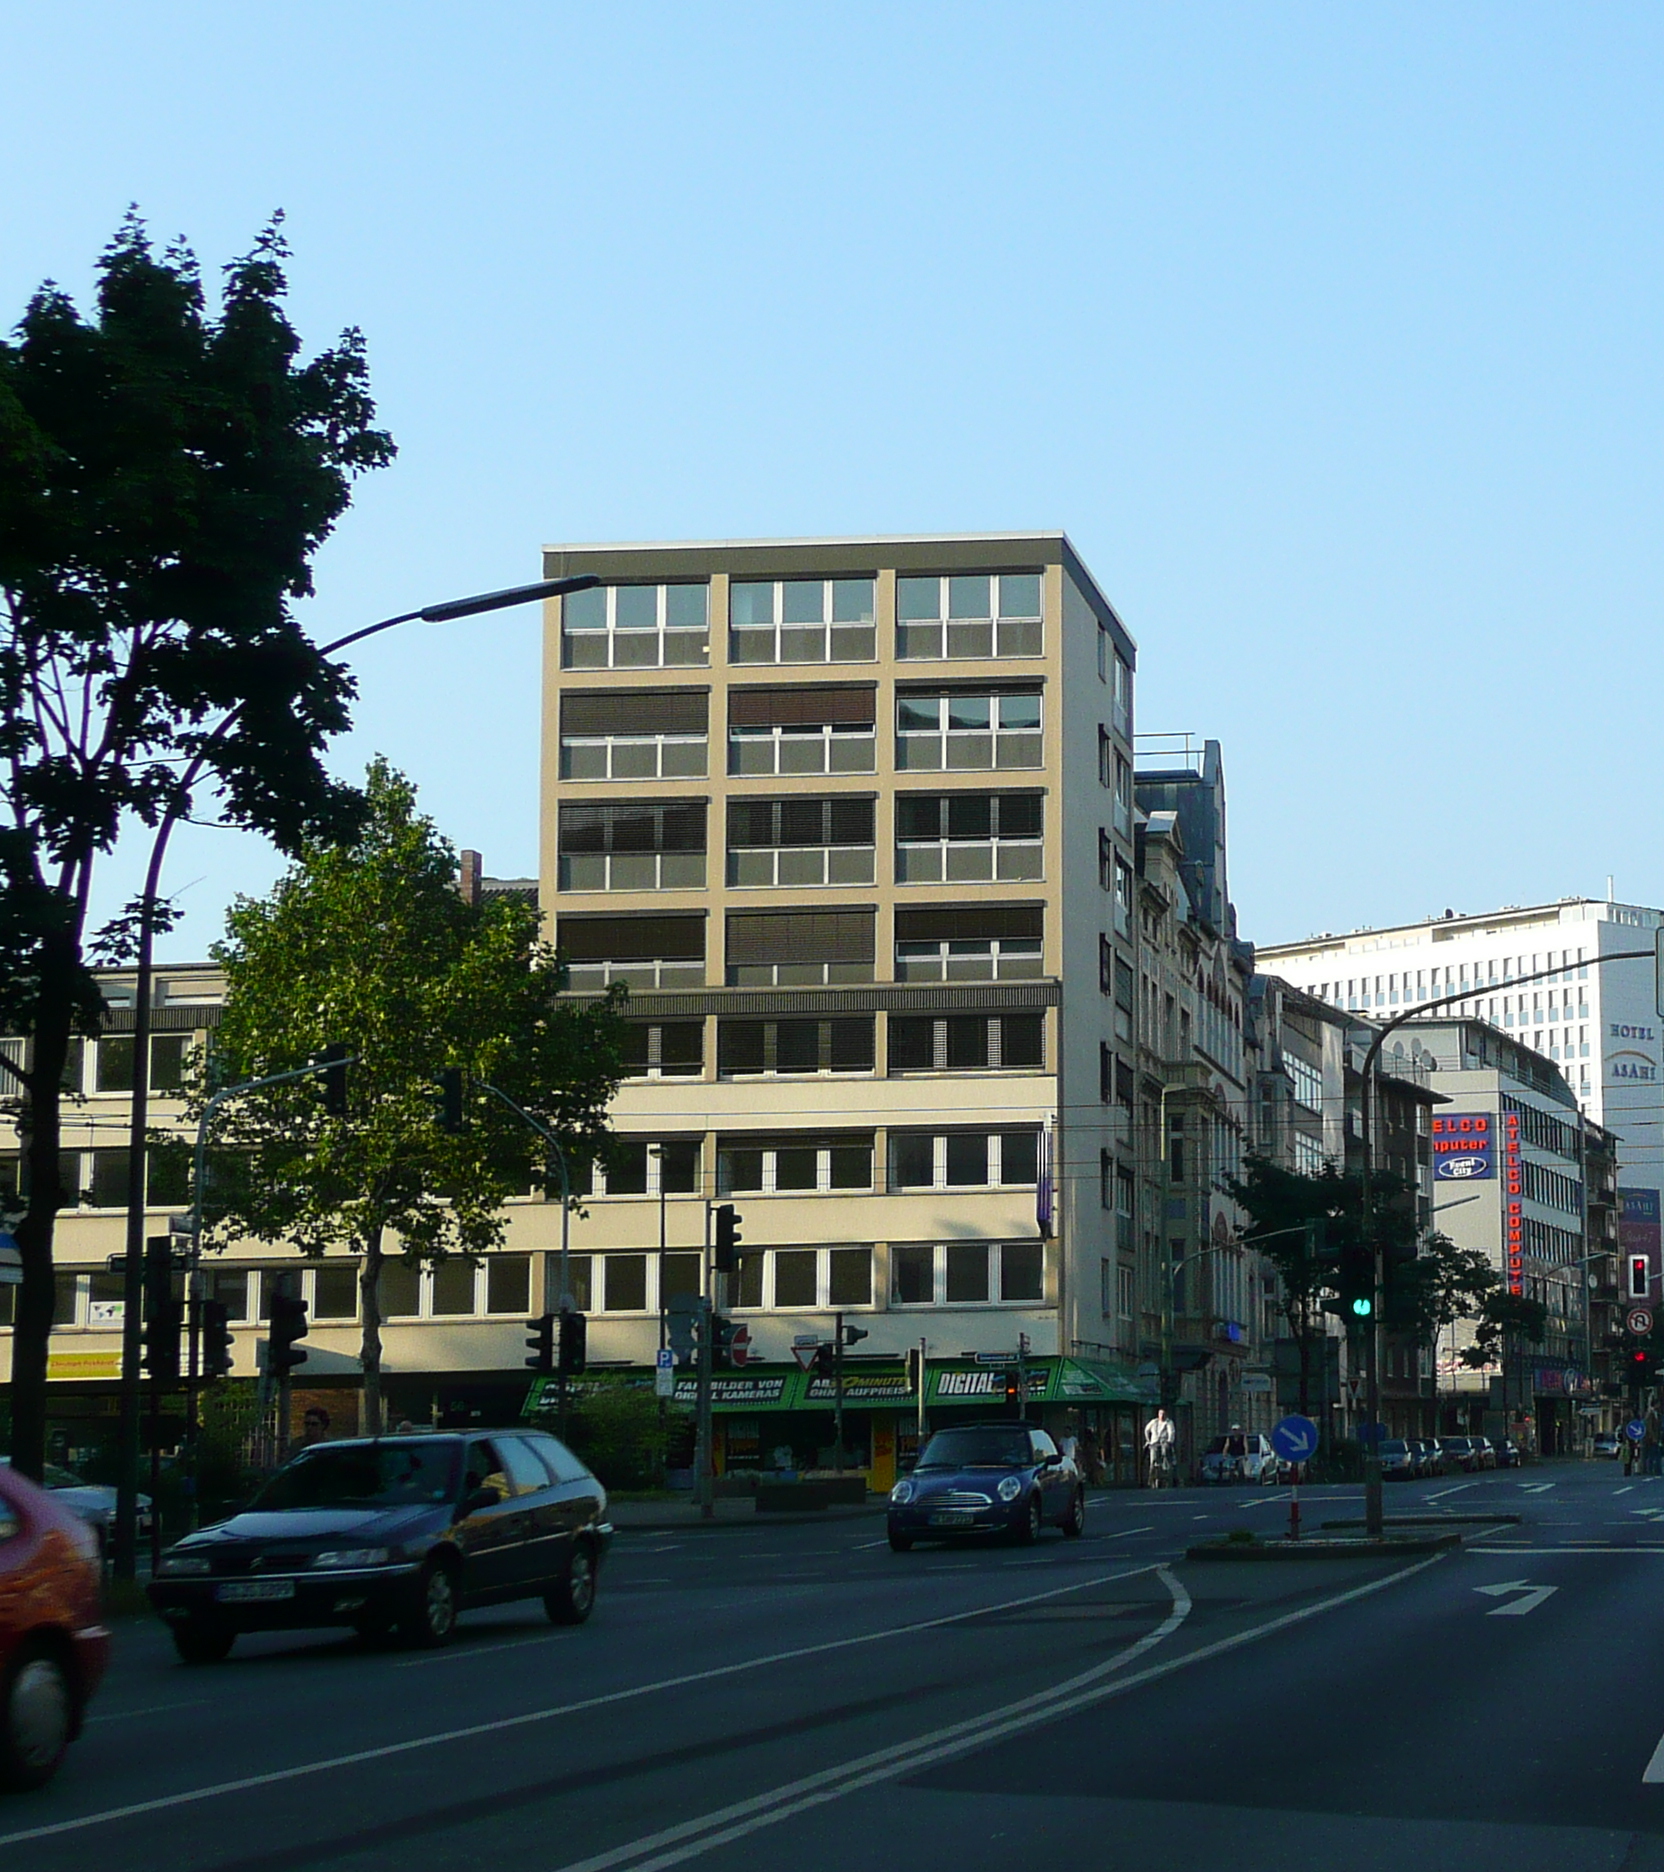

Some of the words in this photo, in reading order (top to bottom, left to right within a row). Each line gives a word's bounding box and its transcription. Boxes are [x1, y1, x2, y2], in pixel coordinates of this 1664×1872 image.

[1610, 1023, 1655, 1040] HOTEL
[1611, 1063, 1656, 1080] ASAHI
[1432, 1118, 1488, 1133] ELCO
[1508, 1203, 1523, 1296] COMPUTE
[660, 1351, 670, 1366] P
[758, 1379, 784, 1390] VON
[858, 1376, 908, 1388] MINUTE
[937, 1371, 995, 1394] DIGITAL
[673, 1390, 719, 1401] DIGIL
[721, 1388, 781, 1400] KAMERAS
[808, 1387, 836, 1399] OHN
[845, 1385, 907, 1397] AUFPREIS
